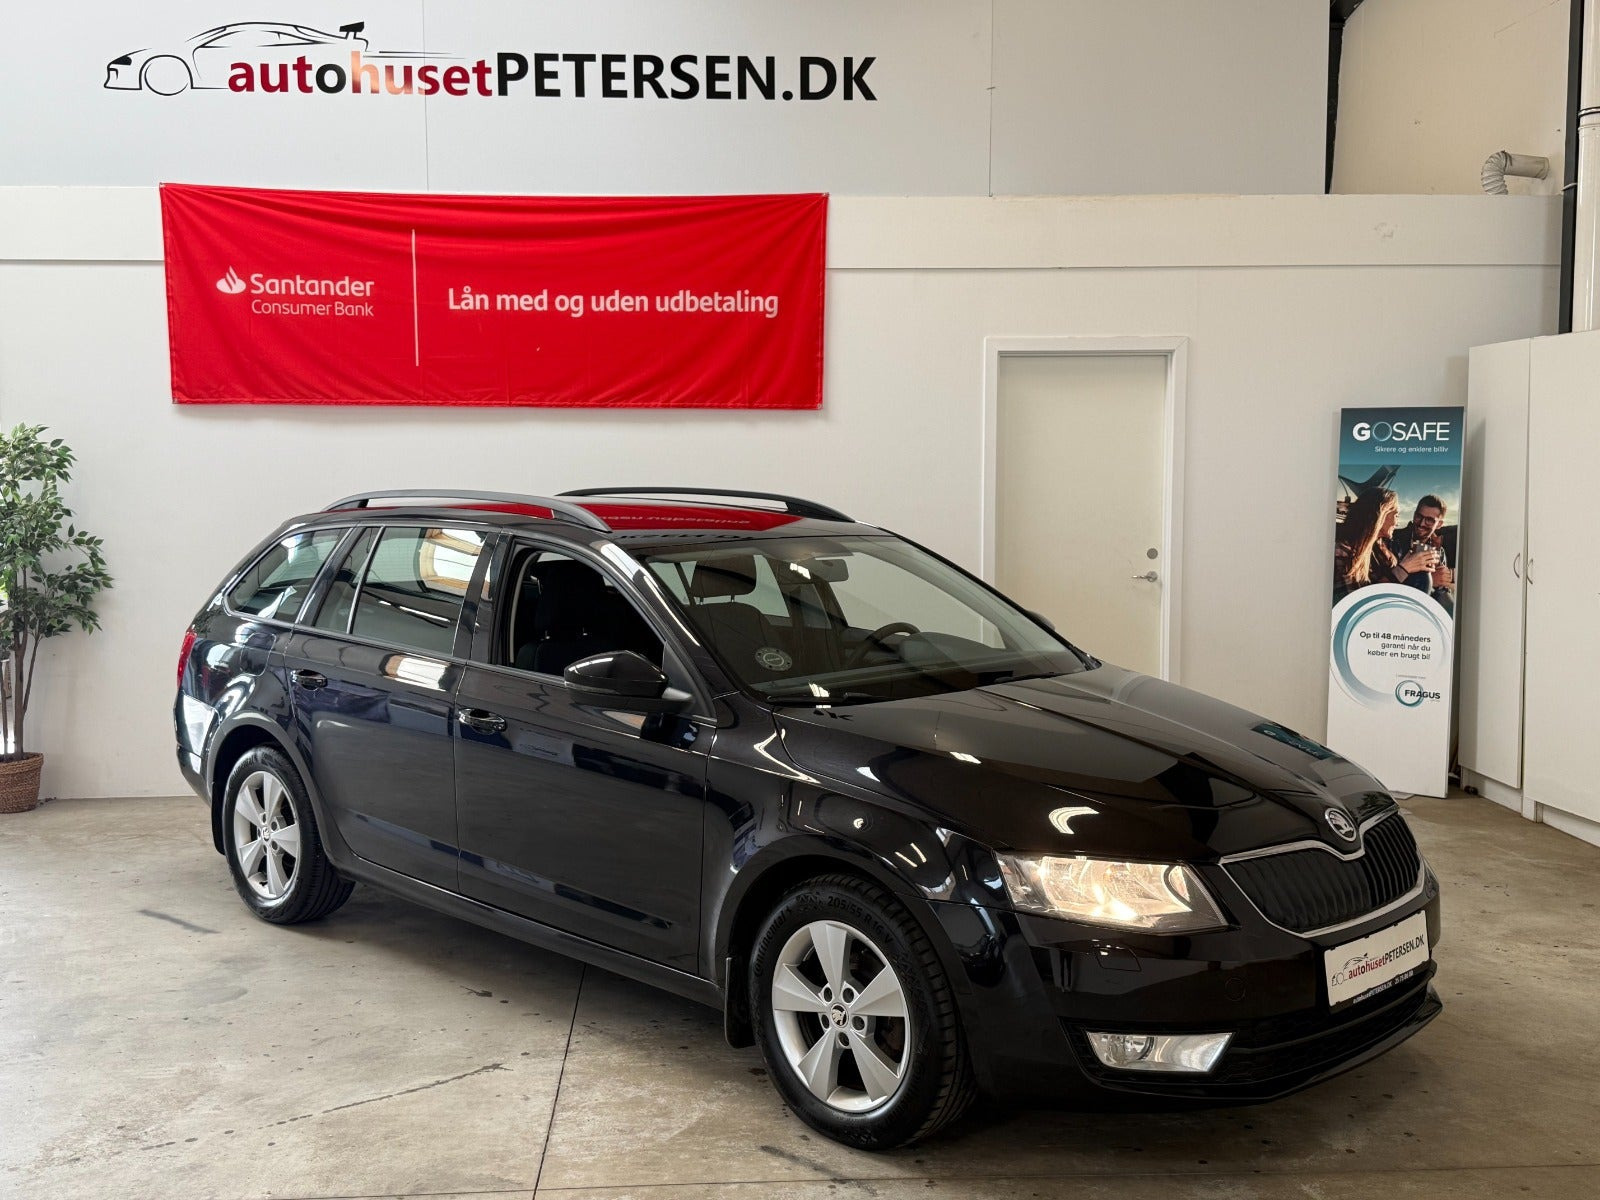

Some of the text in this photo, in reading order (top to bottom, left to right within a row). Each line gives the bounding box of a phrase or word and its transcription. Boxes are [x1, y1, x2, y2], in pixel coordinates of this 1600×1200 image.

[250, 273, 375, 297] Santander
[251, 299, 375, 317] Consumer Bank
[448, 285, 779, 318] Lån med og uden udbetaling
[1352, 421, 1450, 442] GOSAFE
[1374, 445, 1397, 453] Sikrere
[1359, 631, 1371, 639] Op
[1381, 632, 1392, 640] 48
[1392, 633, 1431, 643] måneders
[1381, 642, 1406, 650] garanti
[1407, 643, 1420, 651] når
[1367, 649, 1388, 657] køber
[1400, 651, 1420, 661] brugt
[1404, 689, 1441, 700] FRAGUS
[827, 895, 864, 918] 205/55
